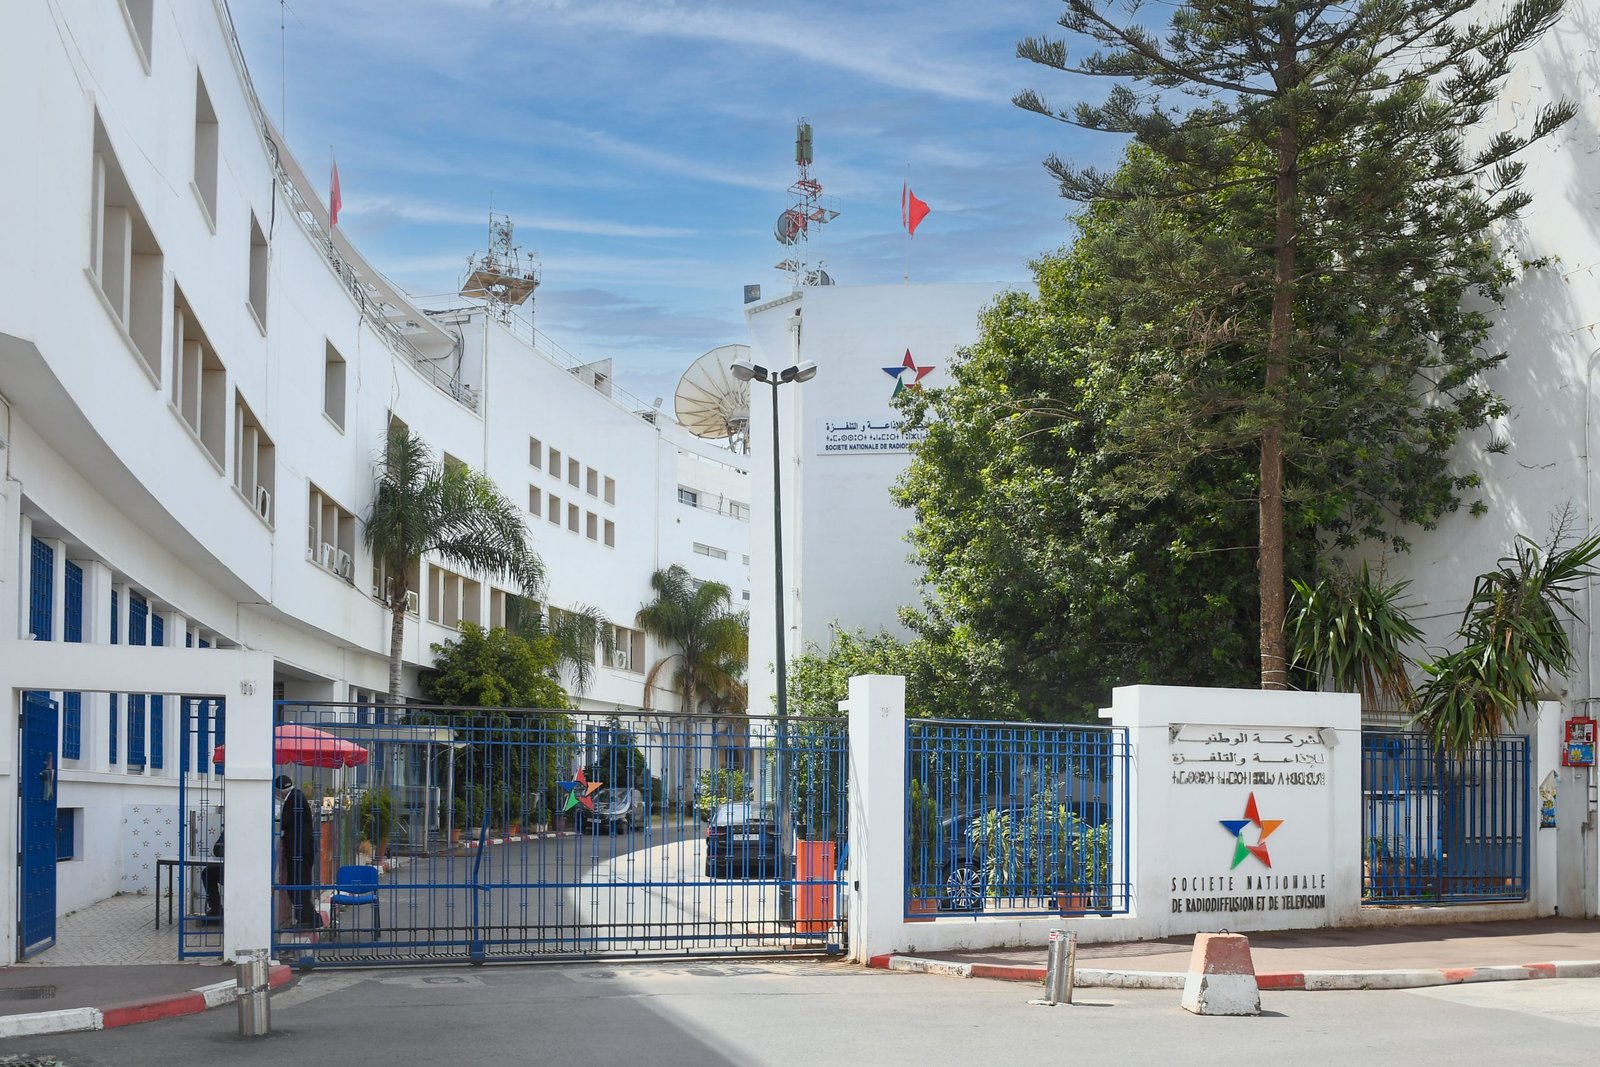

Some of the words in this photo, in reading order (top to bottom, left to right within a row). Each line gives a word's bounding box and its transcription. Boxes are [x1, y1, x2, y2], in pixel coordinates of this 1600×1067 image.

[825, 443, 848, 451] SOCIETE
[1171, 876, 1234, 892] SOCIETE
[1246, 874, 1326, 890] NATIONALE
[1172, 898, 1183, 913] DE
[1185, 896, 1254, 913] RADIODIFFUSION
[1256, 896, 1266, 911] ET
[1268, 895, 1279, 911] DE
[1282, 894, 1326, 910] TELEVISION
